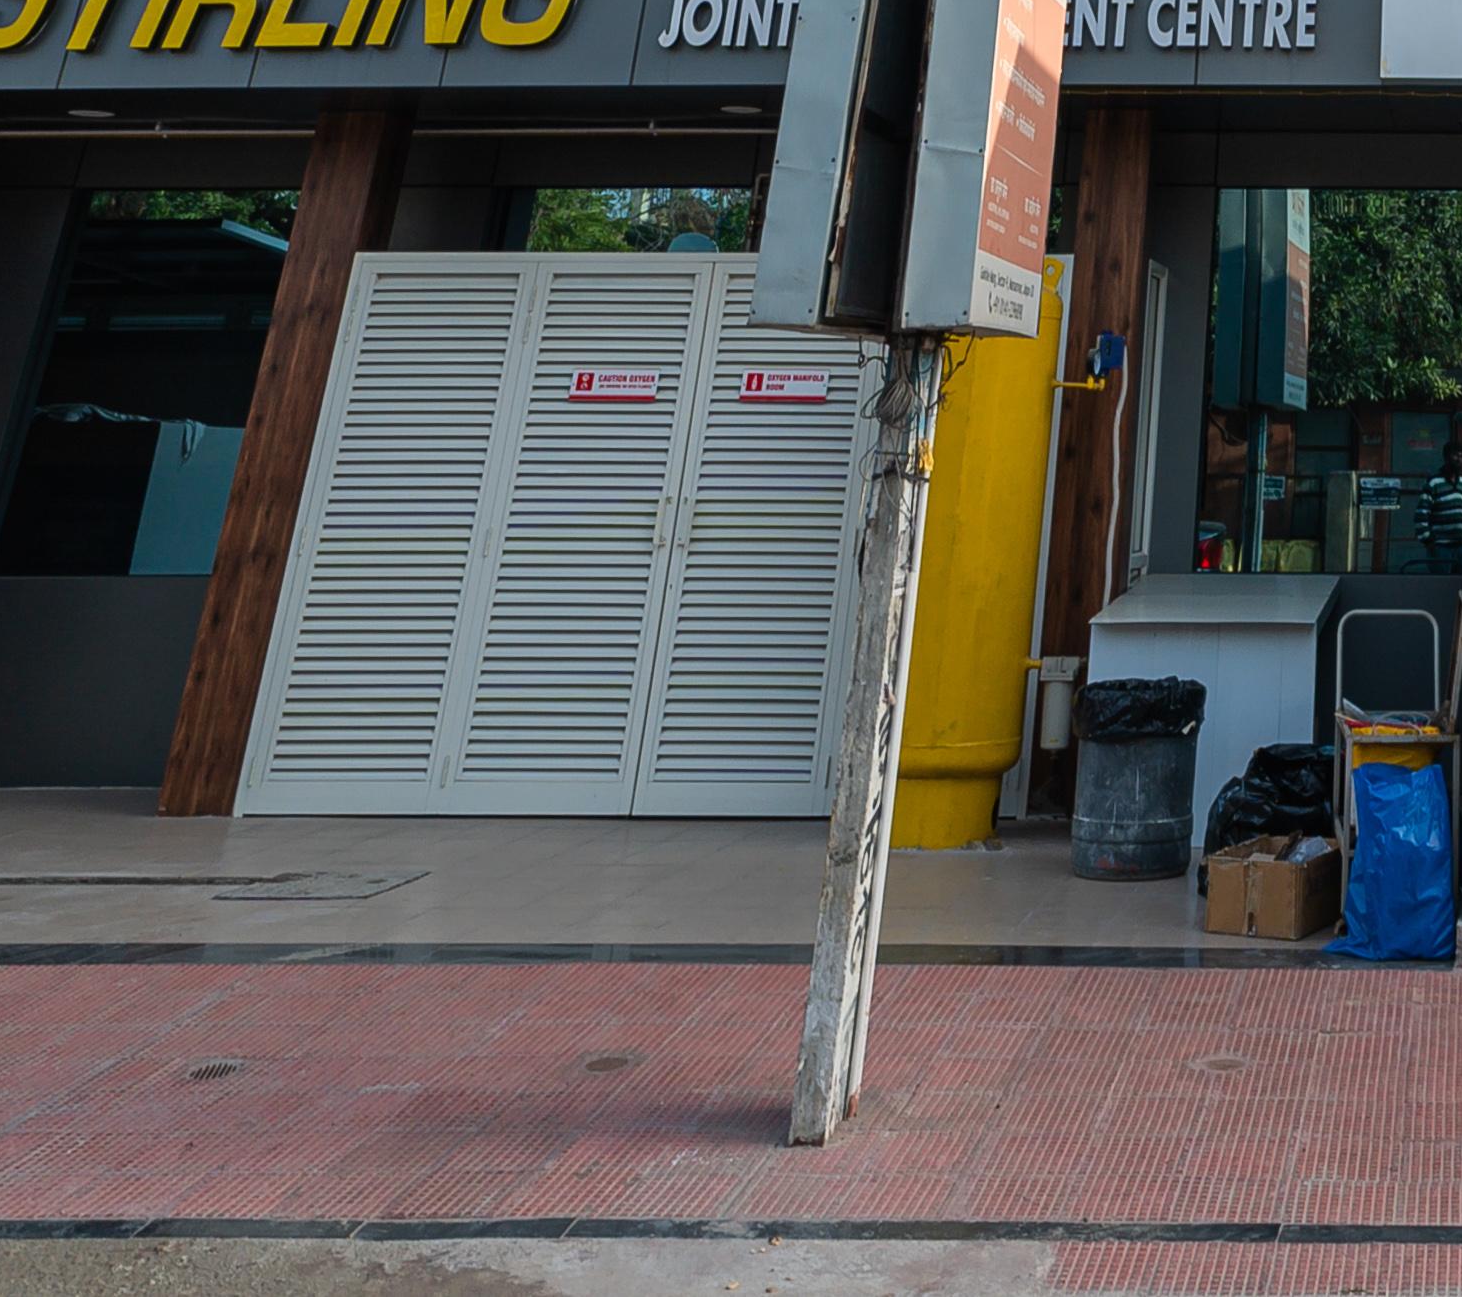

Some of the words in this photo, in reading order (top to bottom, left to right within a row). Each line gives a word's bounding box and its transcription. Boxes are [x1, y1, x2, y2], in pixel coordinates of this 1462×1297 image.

[599, 374, 627, 382] CAUTION
[629, 374, 655, 382] OXYGEN
[793, 374, 824, 382] MANIFOLD
